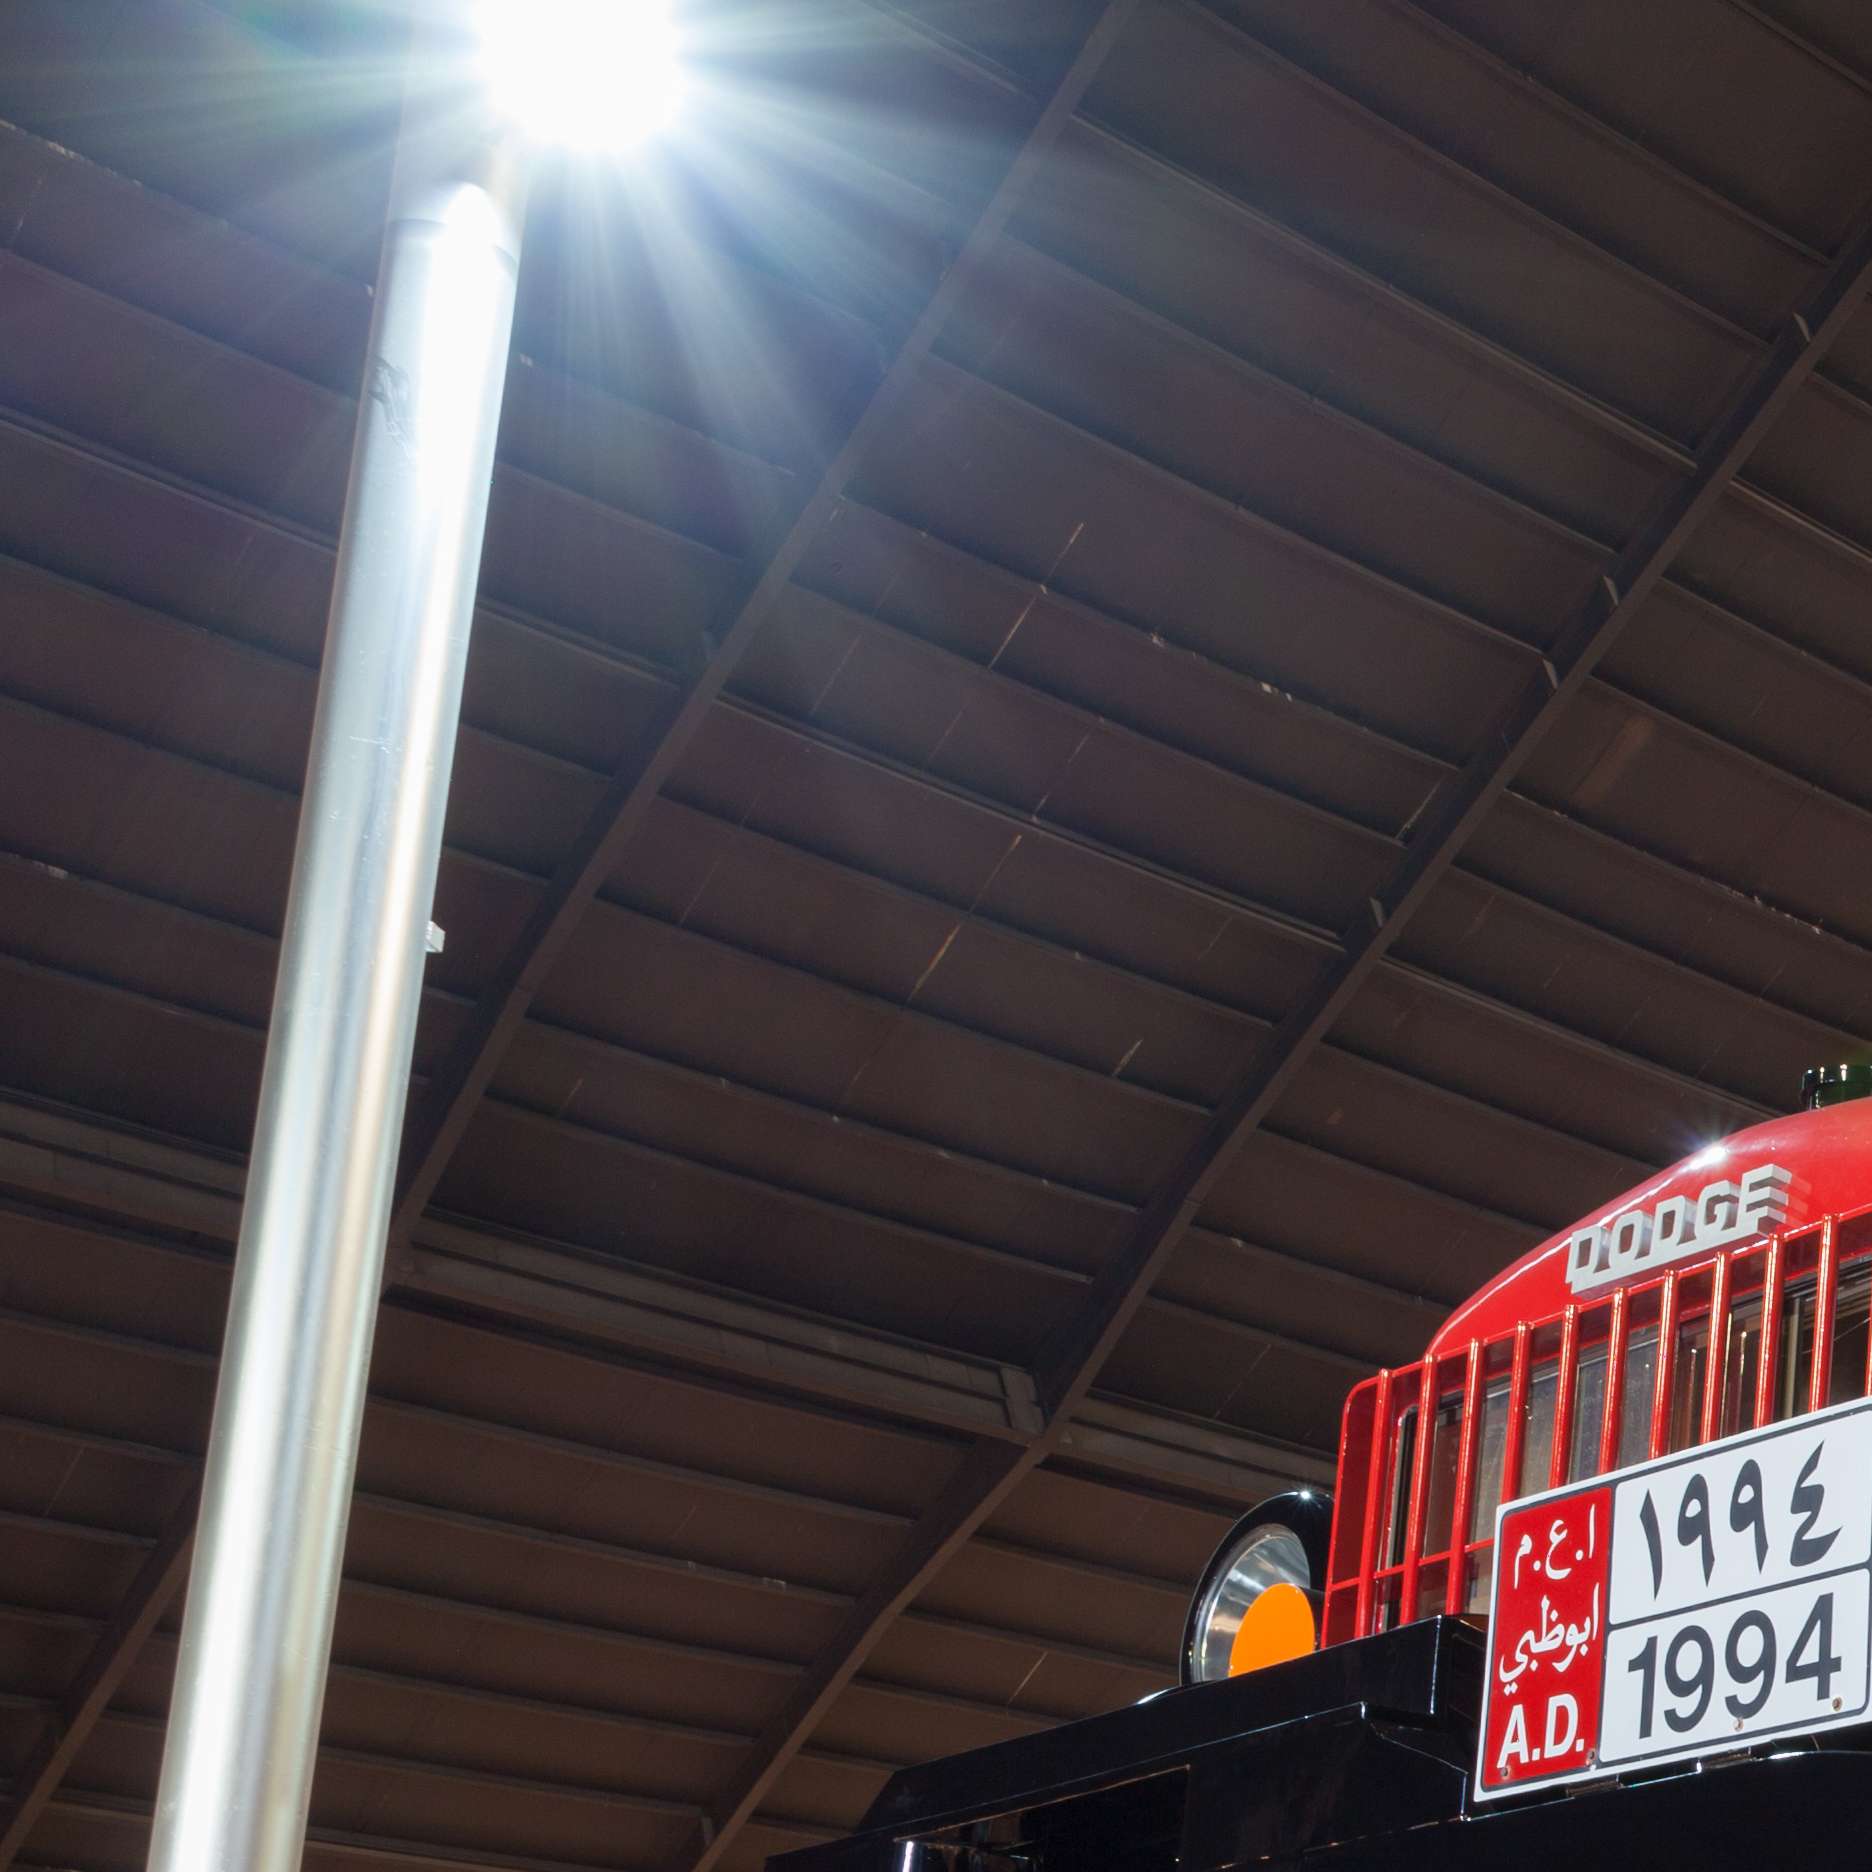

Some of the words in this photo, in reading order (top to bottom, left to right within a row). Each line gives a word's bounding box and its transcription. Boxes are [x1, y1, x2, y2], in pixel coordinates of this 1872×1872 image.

[1565, 1163, 1792, 1293] DODGE
[1639, 1440, 1843, 1600] ١٩٩٤
[1496, 1693, 1585, 1769] A.D.
[1627, 1592, 1842, 1740] 1994
